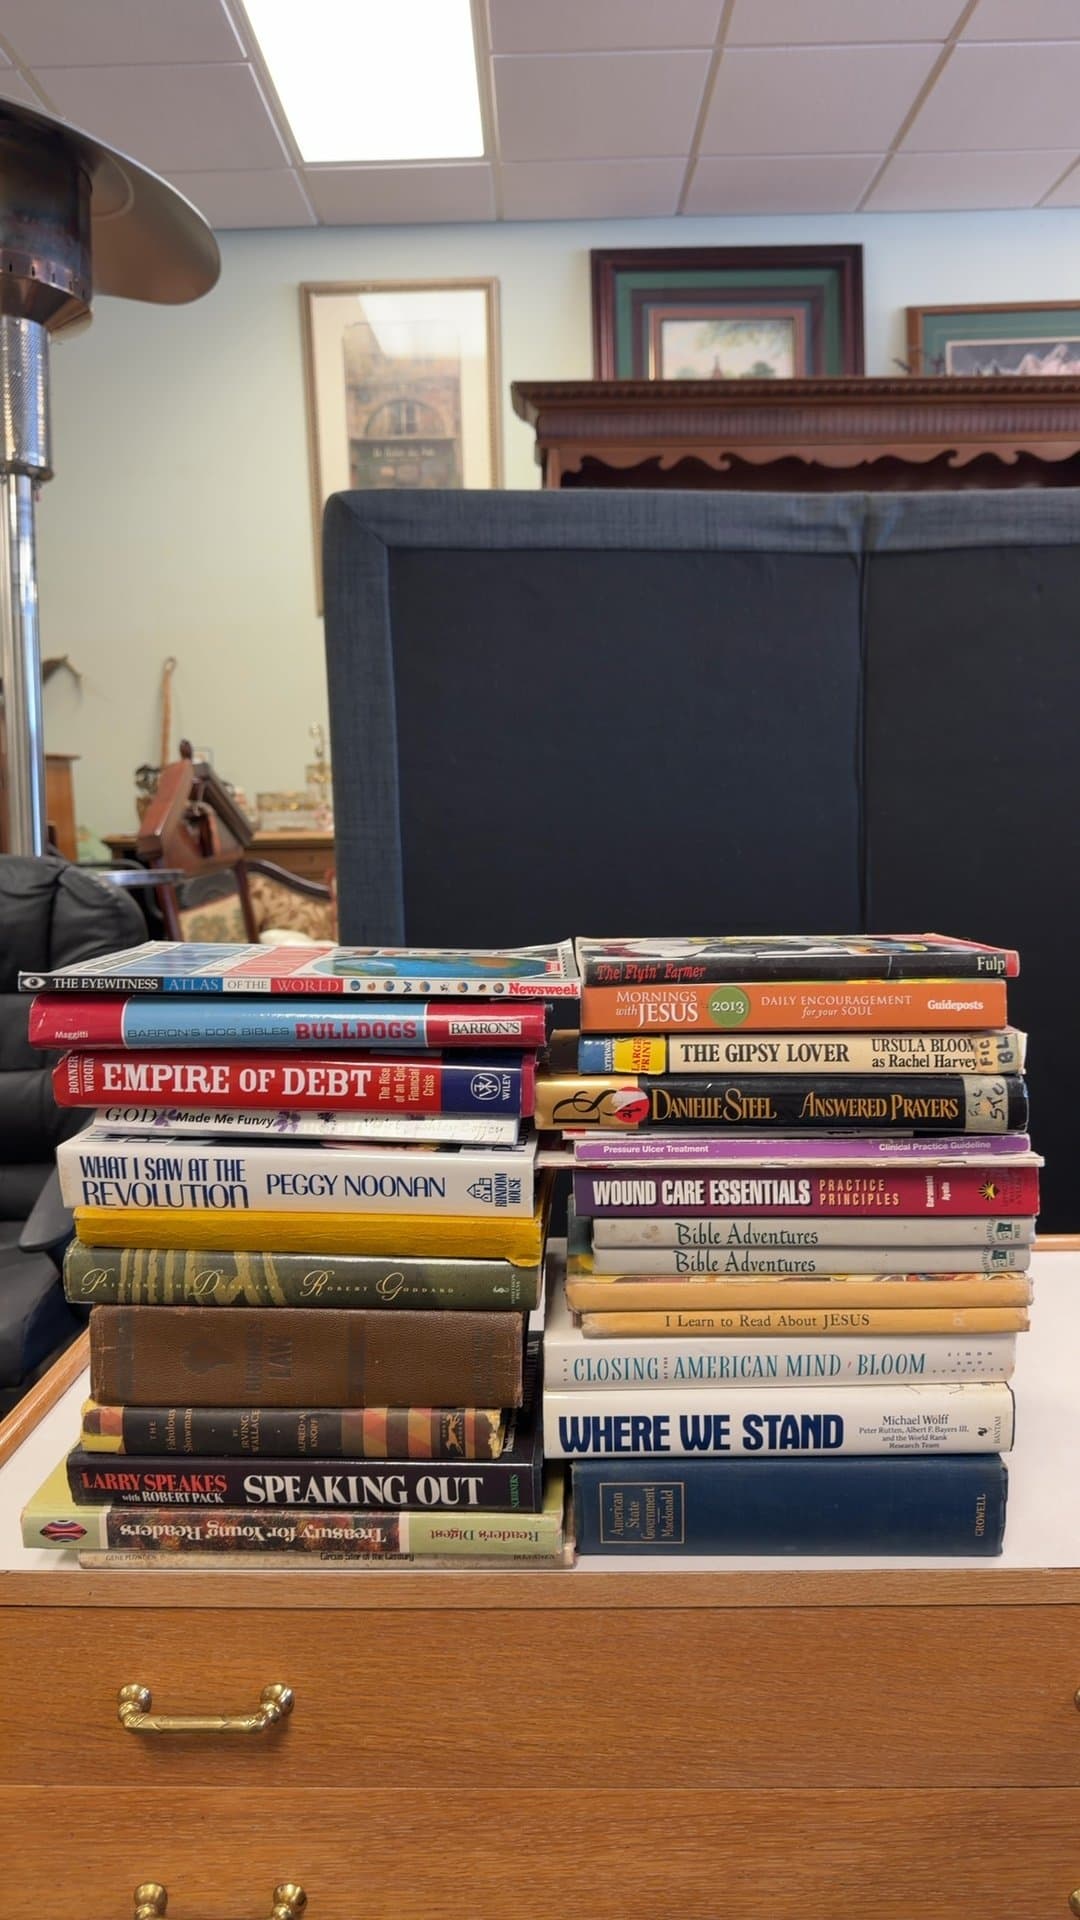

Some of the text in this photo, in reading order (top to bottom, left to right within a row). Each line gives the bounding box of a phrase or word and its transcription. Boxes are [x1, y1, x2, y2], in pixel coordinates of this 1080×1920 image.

[597, 964, 620, 980] The
[665, 964, 706, 982] Farmer
[977, 956, 1005, 974] Fulp
[53, 978, 340, 992] THE EYEWITNESS ATLAS OF THE WORLD
[508, 982, 579, 996] Newsweek
[616, 991, 697, 1002] MORNINGS
[711, 1000, 745, 1014] 2013
[761, 995, 912, 1006] DAILY ENCOURAGEMENT
[928, 1000, 984, 1012] Guideposts
[616, 1002, 698, 1027] with JESUS
[802, 1006, 873, 1019] for your SOUL
[55, 1030, 89, 1040] Maggitti
[128, 1022, 417, 1040] BARRON'S DOG BIBLES BULLDOGS
[451, 1022, 521, 1036] BARRON'S
[632, 1037, 642, 1071] LARGE
[642, 1040, 651, 1072] PRINT
[681, 1043, 850, 1063] THE GIPSY LOVER
[872, 1039, 924, 1052] URSULA
[872, 1055, 977, 1071] as Rachel Harvey
[69, 1055, 80, 1095] BONNER
[84, 1056, 95, 1094] WIGGIN
[102, 1063, 372, 1097] EMPIRE OF DEBT
[379, 1068, 390, 1100] The Rise
[409, 1068, 420, 1101] Financial
[423, 1074, 435, 1096] Crisis
[502, 1074, 511, 1101] WILEY
[105, 1107, 157, 1123] GOD
[176, 1111, 210, 1124] Made
[214, 1112, 234, 1125] Me
[652, 1088, 723, 1120] DANIELLE
[723, 1088, 777, 1121] STEEL
[799, 1091, 959, 1120] ANSWERED PRAYERS
[603, 1144, 710, 1154] Pressure Ulcer Treatment
[879, 1140, 992, 1152] Clinical Practice Guideline
[79, 1156, 247, 1183] WHAT I SAW AT THE
[82, 1180, 250, 1209] REVOLUTION
[266, 1173, 446, 1198] PEGGY NOONAN
[495, 1173, 508, 1208] RANDOM
[508, 1178, 521, 1204] HOUSE
[592, 1179, 811, 1206] WOUND CARE ESSENTIALS
[819, 1178, 885, 1192] PRACTICE
[819, 1193, 900, 1206] PRINCIPLES
[674, 1222, 819, 1245] Bible Adventures
[672, 1250, 817, 1273] Bible Adventures
[300, 1270, 455, 1301] ROBERT GODDARD
[666, 1314, 870, 1330] I Learn to Read About JESUS
[574, 1357, 659, 1382] CLOSING
[674, 1355, 778, 1380] AMERICAN
[786, 1354, 842, 1377] MIND
[856, 1353, 926, 1376] BLOOM
[184, 1408, 193, 1453] Showman
[860, 1427, 878, 1435] Peter
[906, 1426, 927, 1434] Albert
[882, 1414, 949, 1426] Michael Wolff
[240, 1415, 249, 1449] IRVING
[558, 1415, 671, 1453] WHERE
[679, 1414, 731, 1451] WE
[742, 1414, 844, 1450] STAND
[882, 1434, 895, 1442] and
[896, 1434, 907, 1442] the
[908, 1434, 929, 1442] World
[81, 1472, 228, 1494] LARRY SPEAKES
[243, 1474, 484, 1506] SPEAKING OUT
[122, 1490, 225, 1504] with ROBERT PACK
[610, 1492, 623, 1537] American
[626, 1501, 640, 1529] State
[642, 1486, 656, 1540] Government
[661, 1489, 674, 1538] Macdonald
[974, 1494, 987, 1537] CROWELL
[120, 1520, 387, 1543] Treasury for Young Readers
[478, 1528, 539, 1542] Reader's
